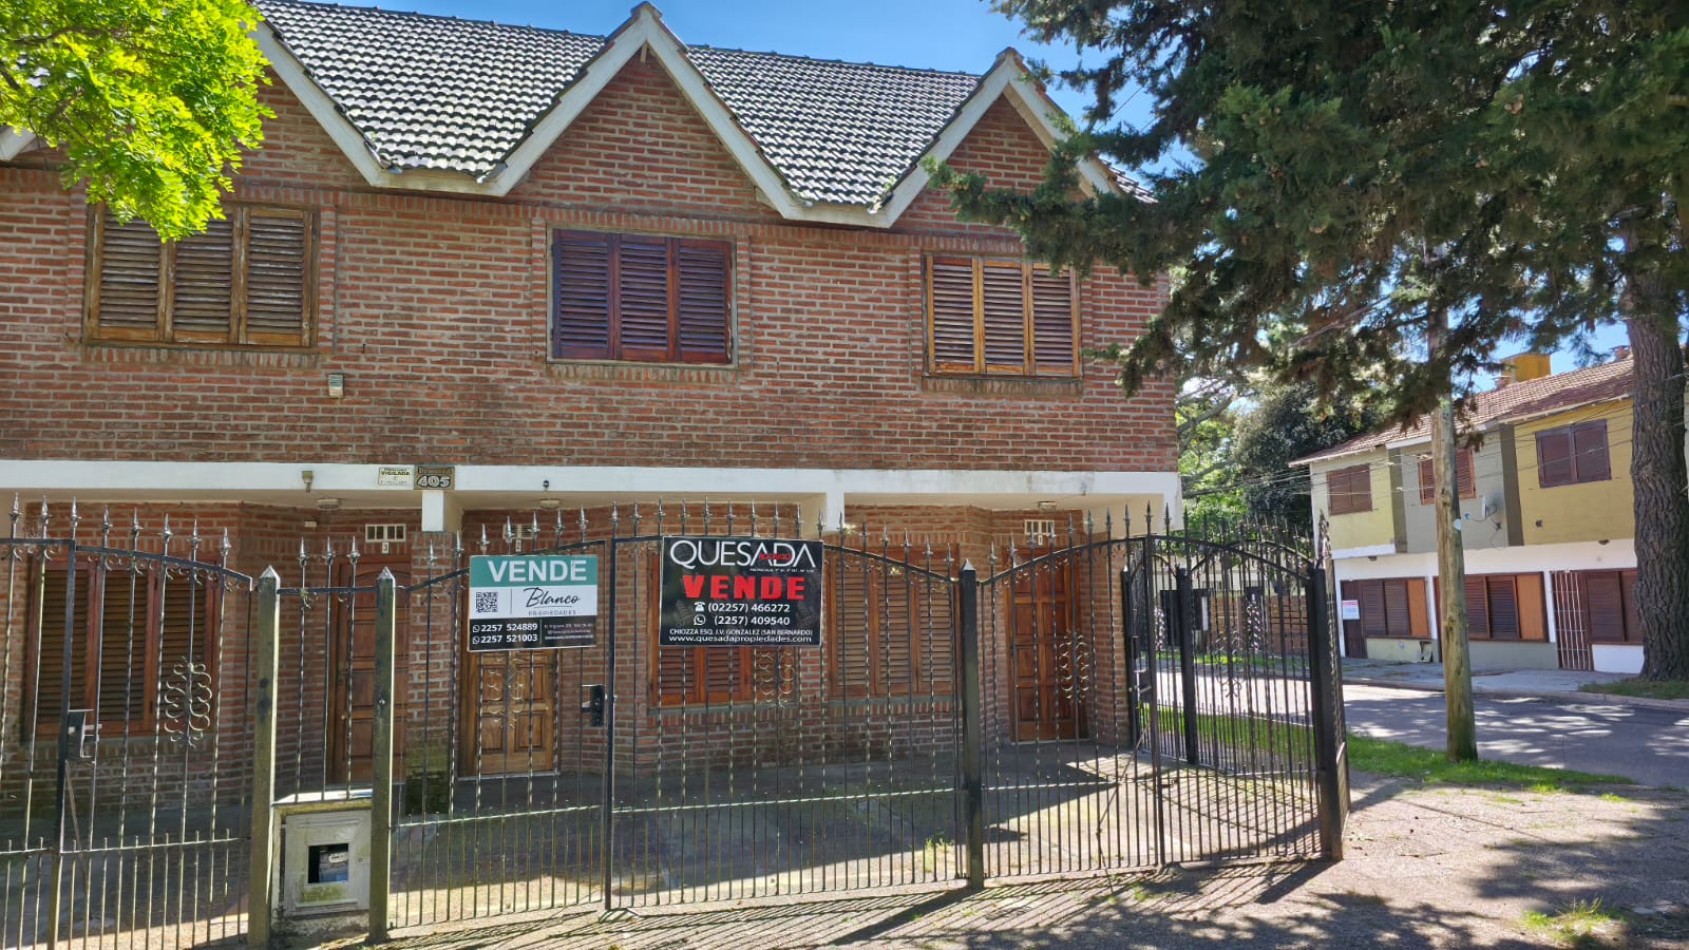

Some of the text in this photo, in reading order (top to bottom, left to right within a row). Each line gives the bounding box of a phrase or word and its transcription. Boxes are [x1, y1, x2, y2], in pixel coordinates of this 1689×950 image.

[417, 475, 451, 488] 405
[669, 539, 816, 569] QUESADA
[488, 560, 587, 582] VENDE
[683, 574, 806, 600] VENDE
[523, 587, 581, 608] Blanco
[708, 603, 790, 613] (02257) 466272
[714, 616, 790, 626] (2257) 409540
[481, 624, 503, 632] 2257
[481, 635, 503, 643] 2257
[507, 634, 538, 642] 521003
[669, 635, 812, 643] www.quesadapropiedades.com
